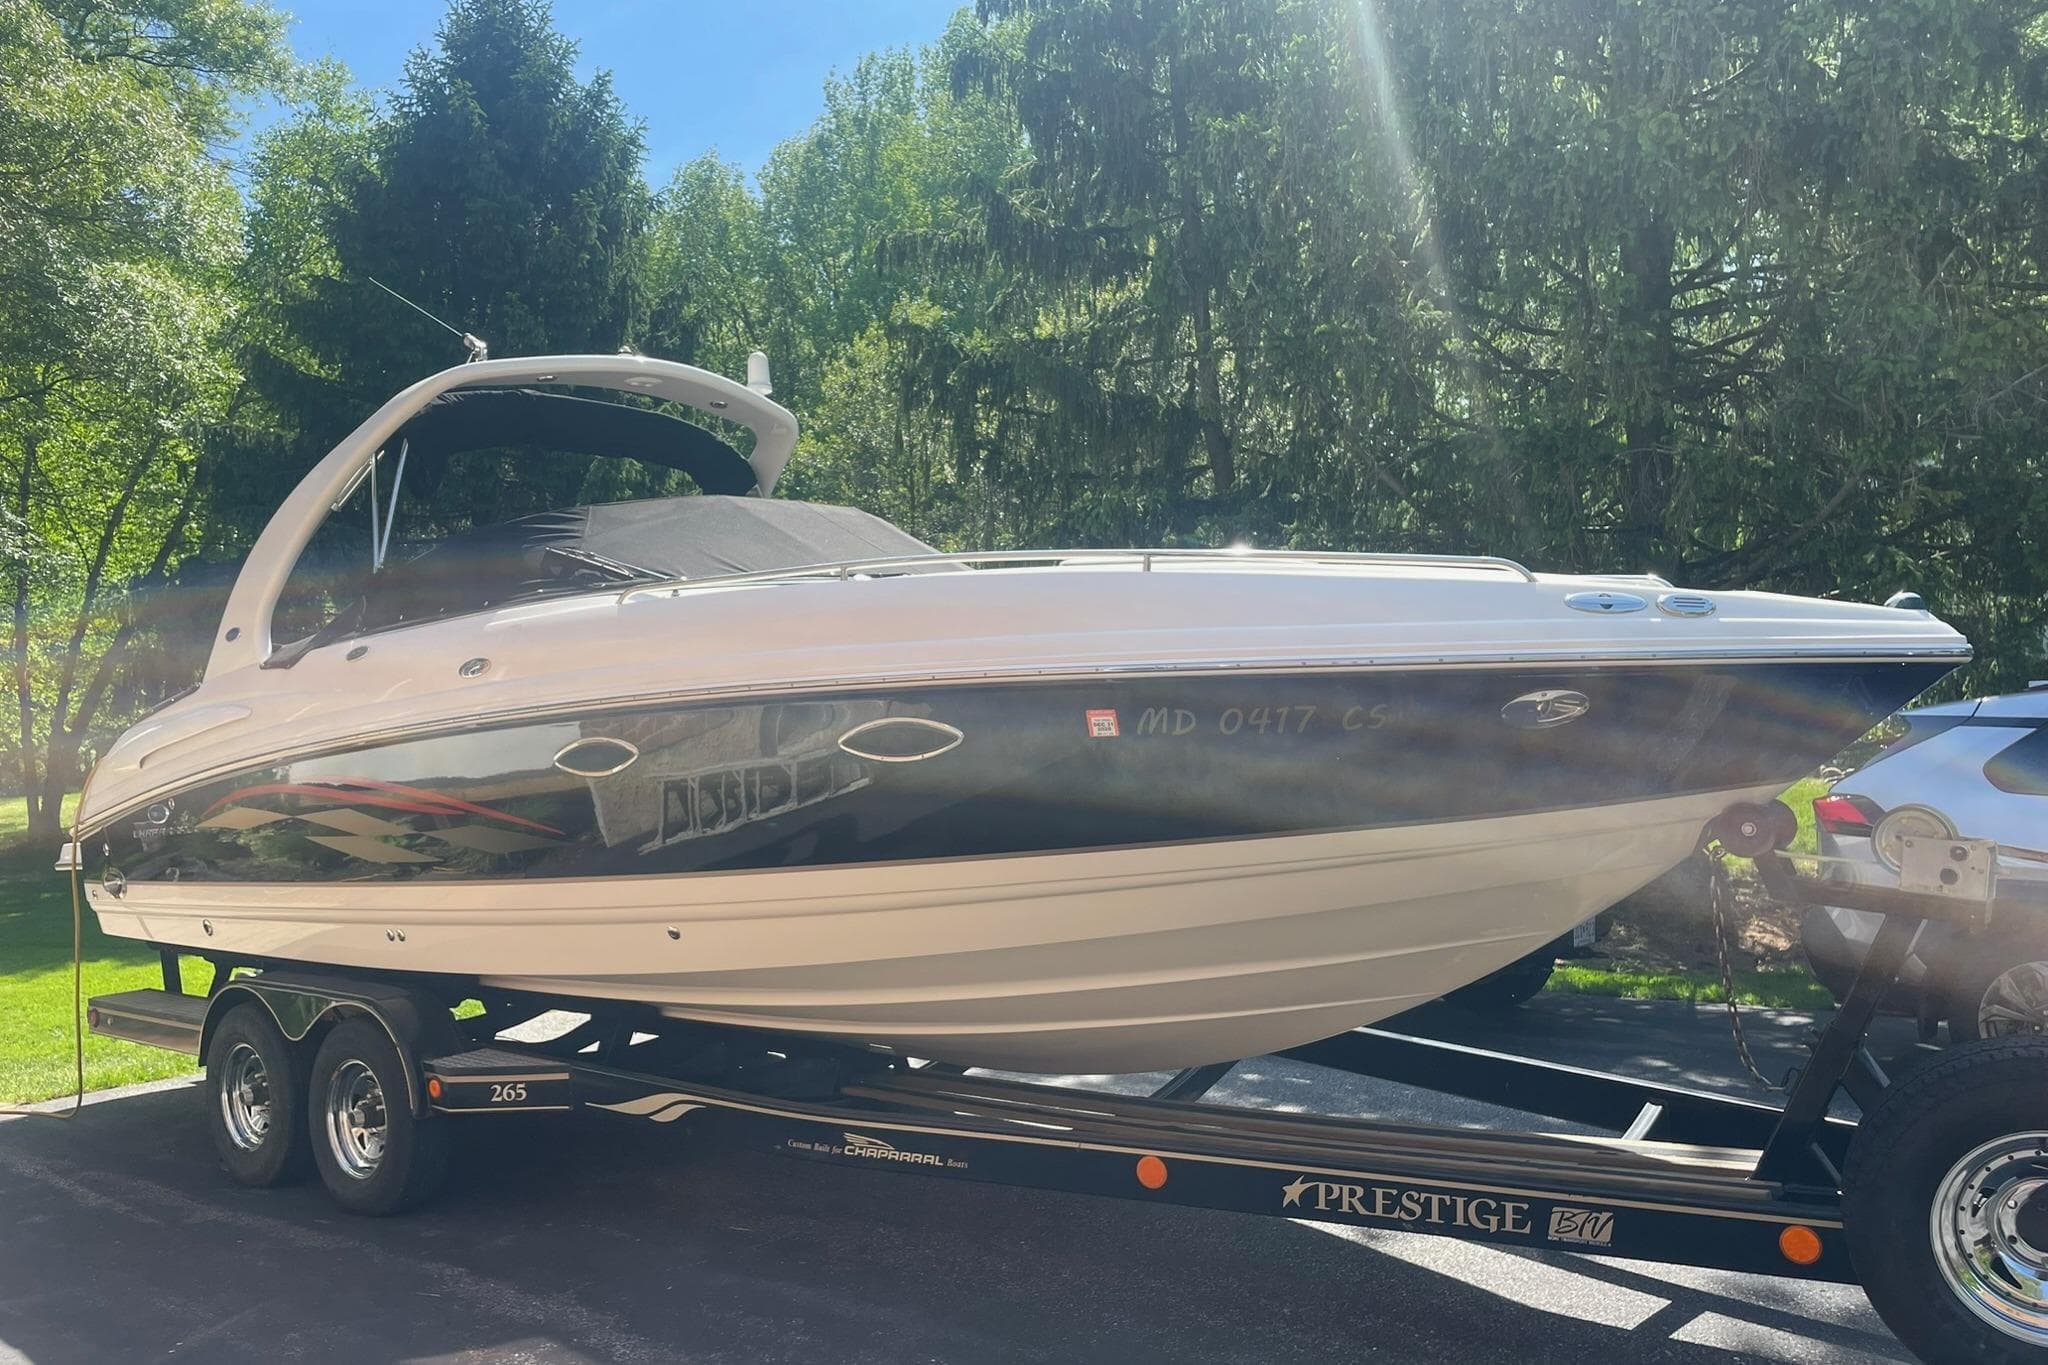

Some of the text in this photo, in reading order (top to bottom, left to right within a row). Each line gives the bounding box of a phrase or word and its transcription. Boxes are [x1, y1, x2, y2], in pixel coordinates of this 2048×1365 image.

[1137, 703, 1387, 736] MD 0417 CS
[490, 1083, 527, 1102] 265
[843, 1145, 944, 1167] CHAPARRAL
[946, 1158, 969, 1169] Boats
[1311, 1181, 1532, 1235] PRESTIGE
